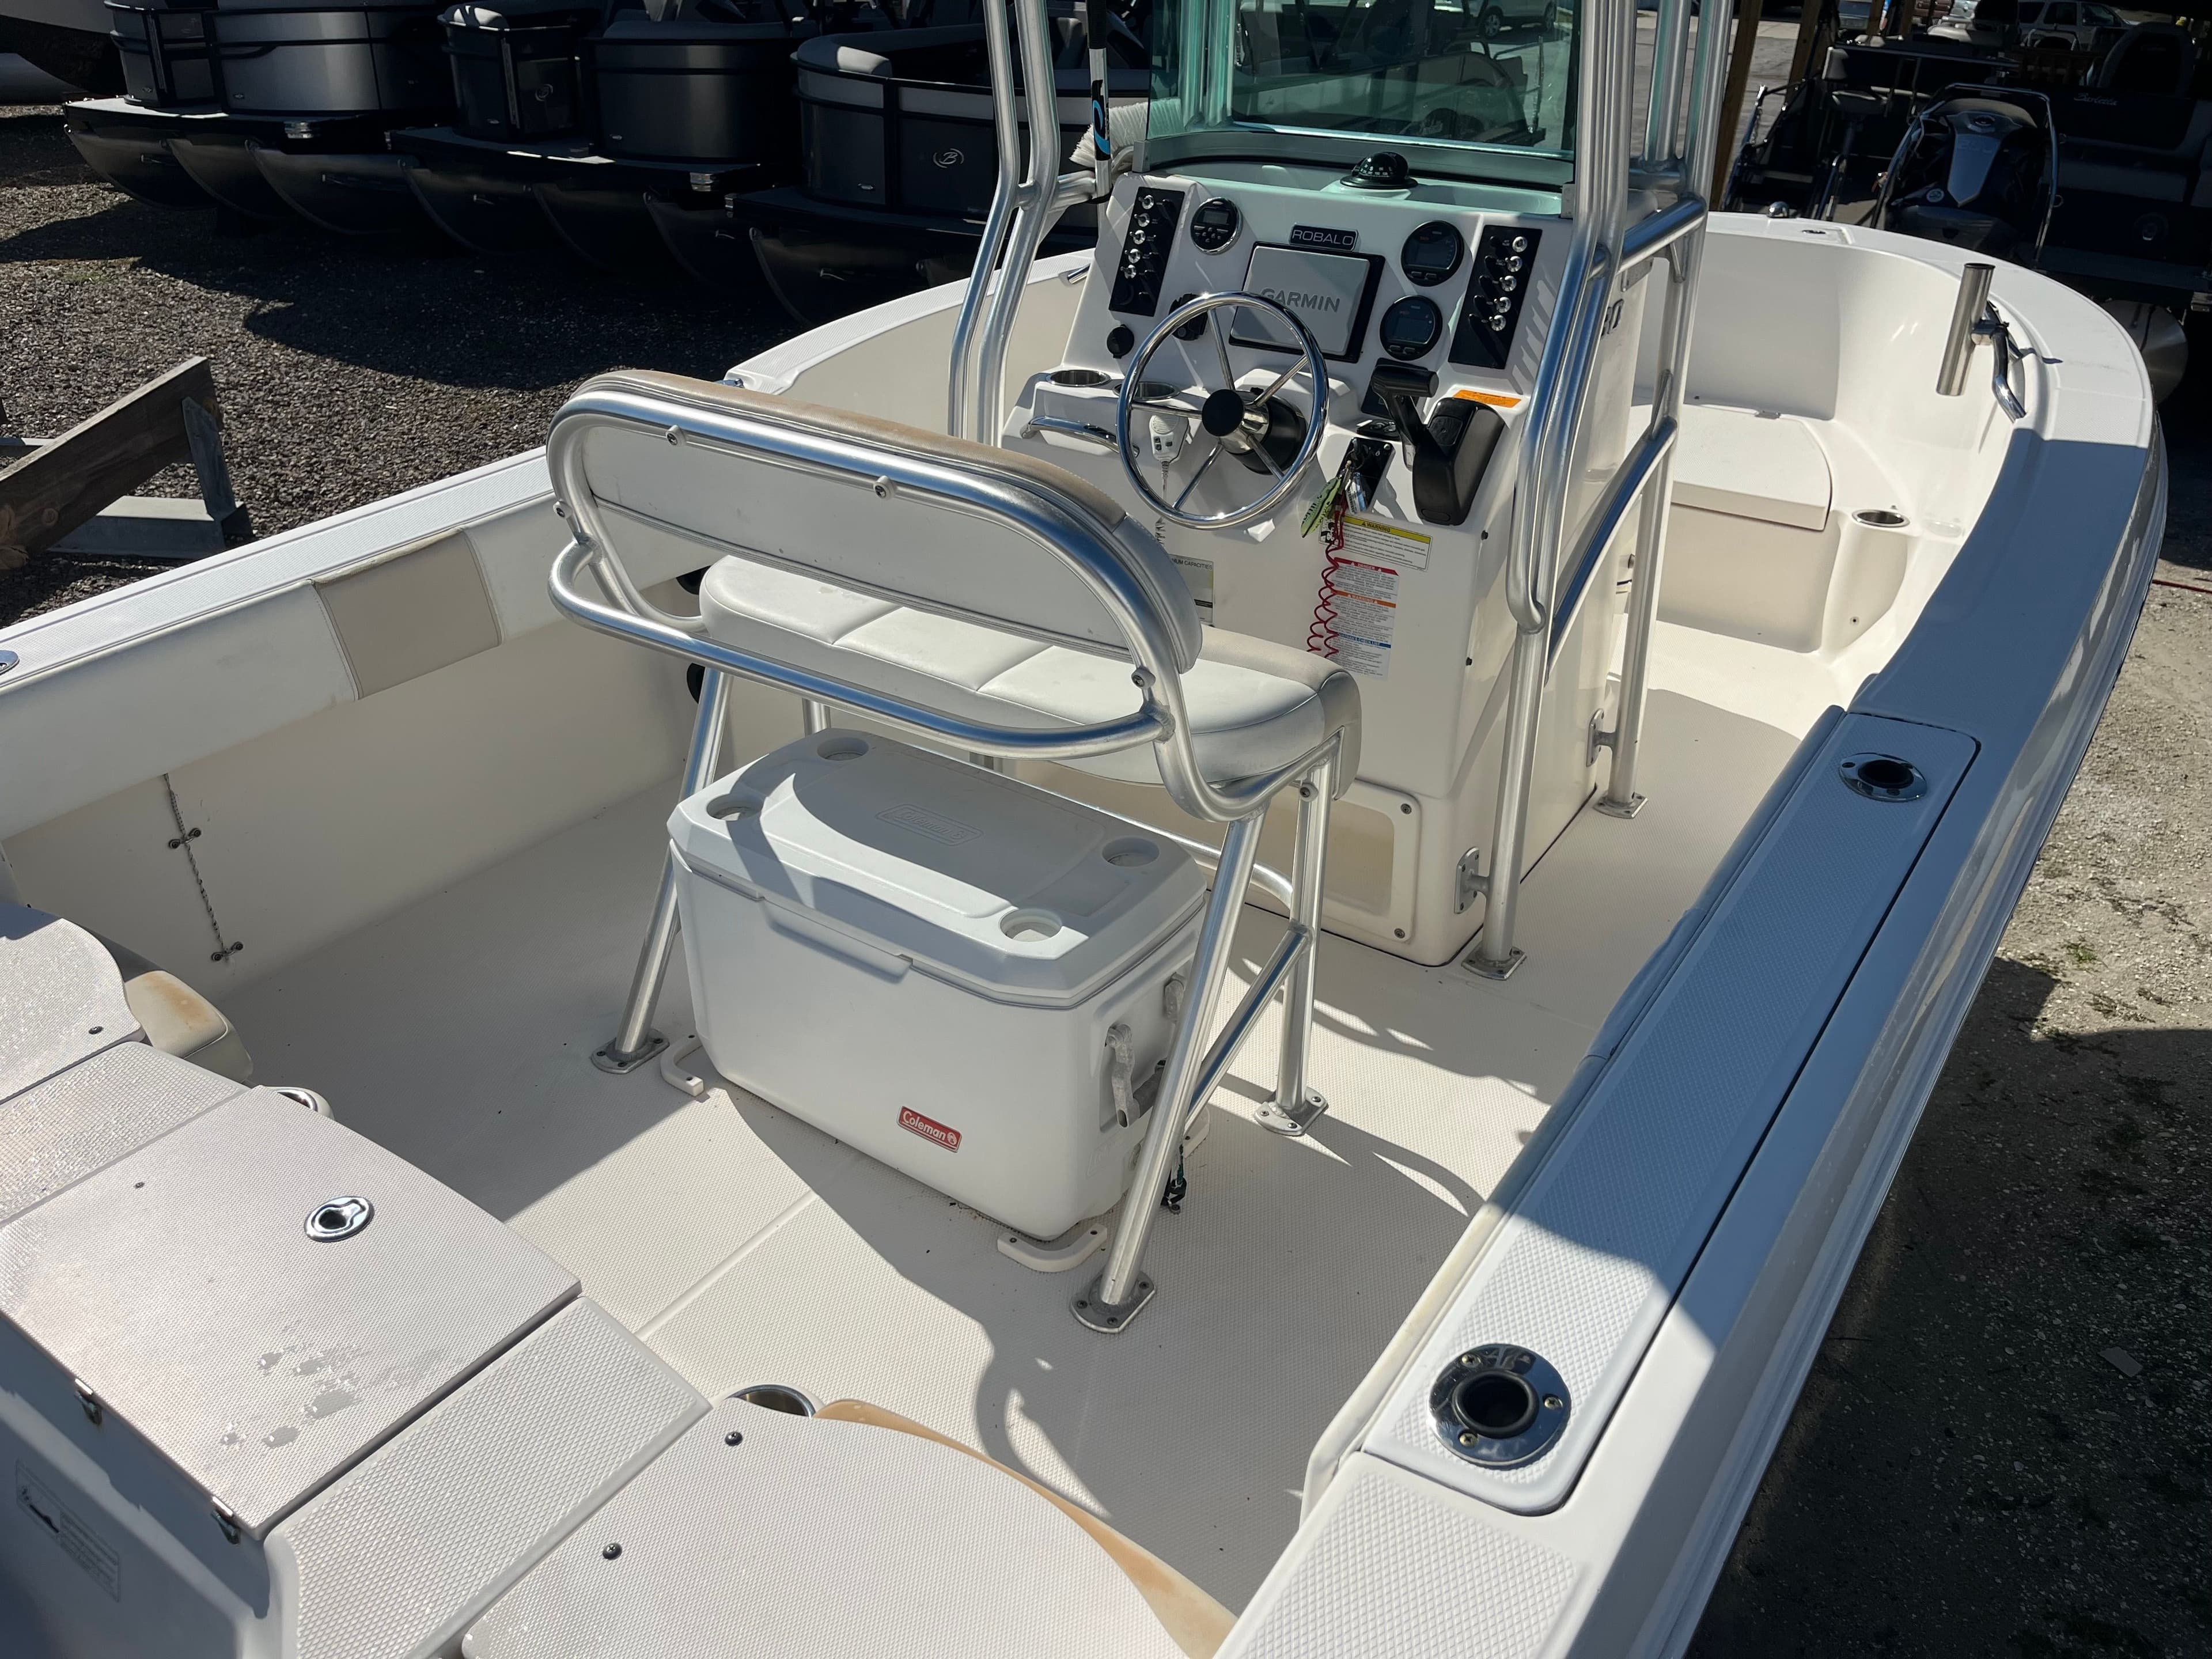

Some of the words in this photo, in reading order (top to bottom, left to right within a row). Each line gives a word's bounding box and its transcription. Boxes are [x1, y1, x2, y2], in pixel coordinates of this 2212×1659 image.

[1292, 229, 1354, 245] ROBALO
[1261, 288, 1340, 313] GARMIN
[1367, 522, 1391, 533] WARNING
[1184, 560, 1213, 570] CAPACITIES
[893, 810, 951, 834] Coleman
[903, 1111, 946, 1141] Coleman
